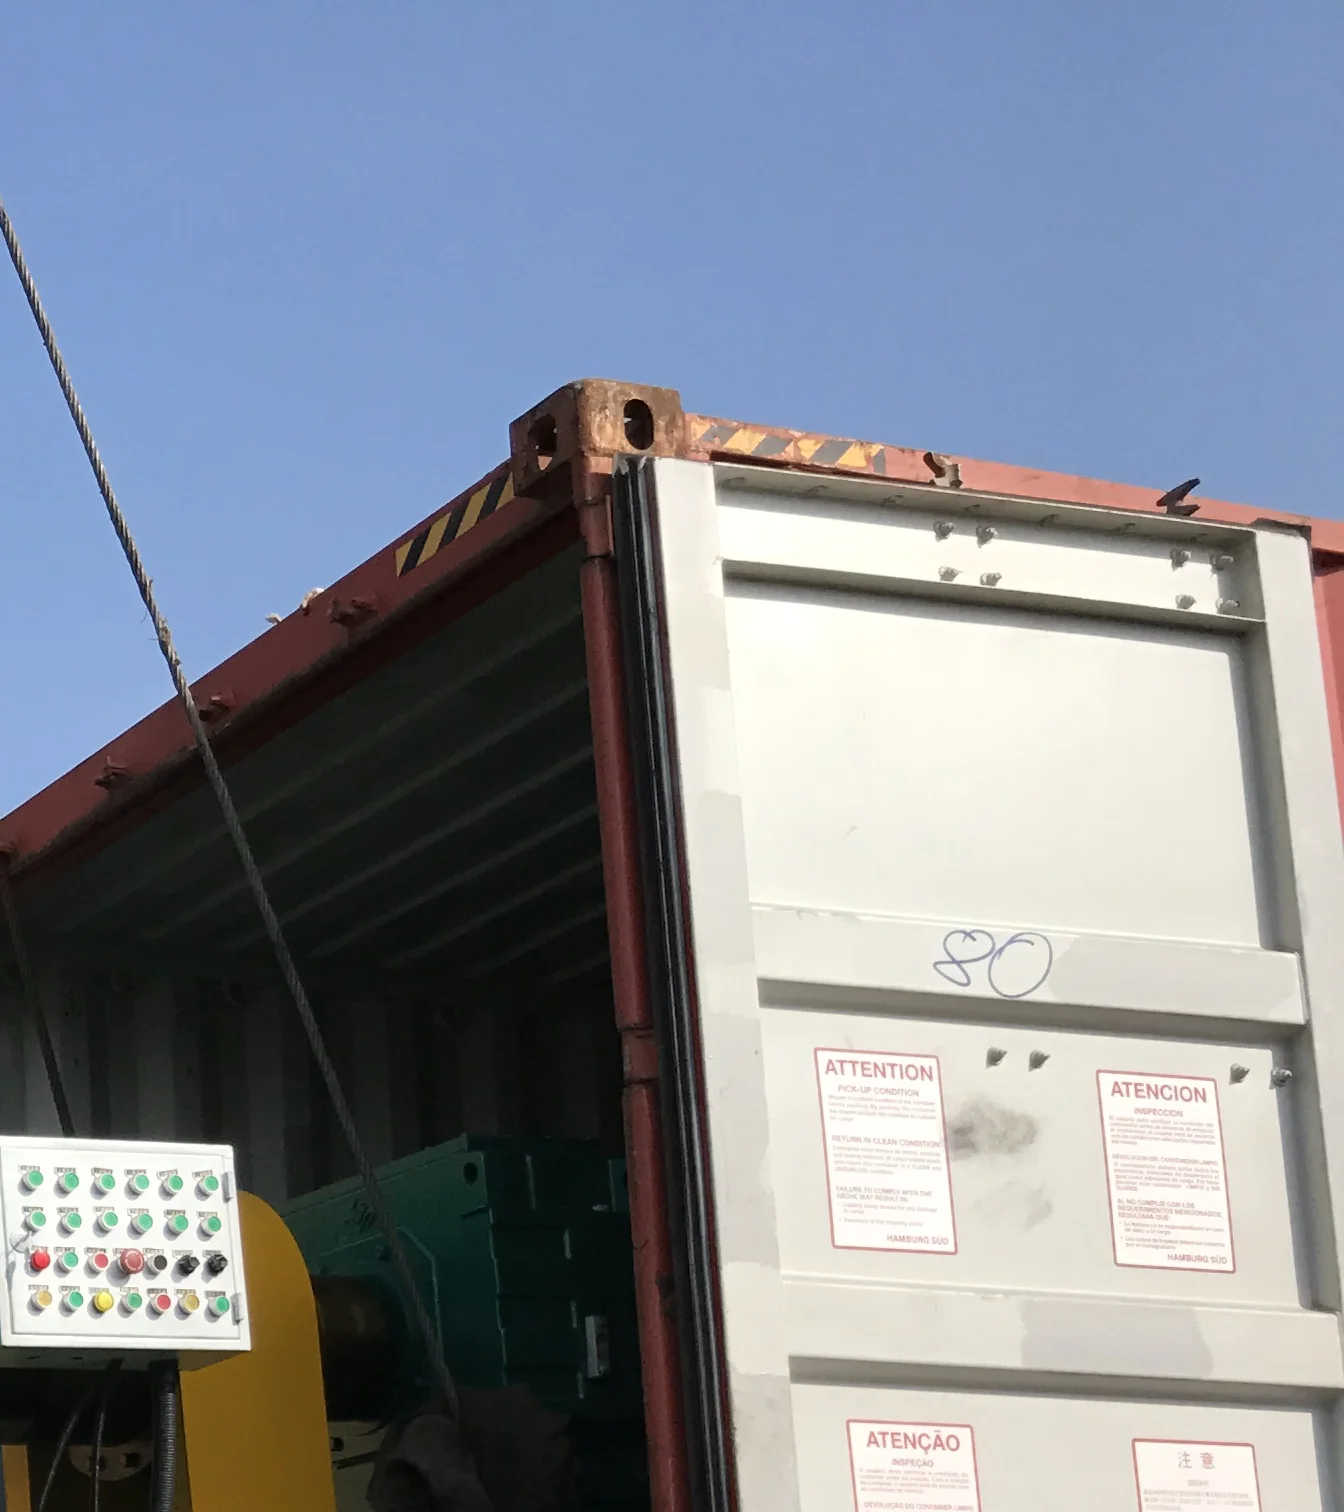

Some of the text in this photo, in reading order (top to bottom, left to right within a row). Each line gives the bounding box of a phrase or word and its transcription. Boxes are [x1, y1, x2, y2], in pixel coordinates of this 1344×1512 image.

[932, 929, 1053, 998] 80
[825, 1059, 933, 1082] ATTENTION
[838, 1084, 919, 1097] PICK-UP CONDITION
[1110, 1081, 1207, 1103] ATENCION
[887, 1234, 929, 1244] HAMBURG
[1167, 1253, 1209, 1263] HAMBURG
[866, 1429, 960, 1455] ATENÇÃO
